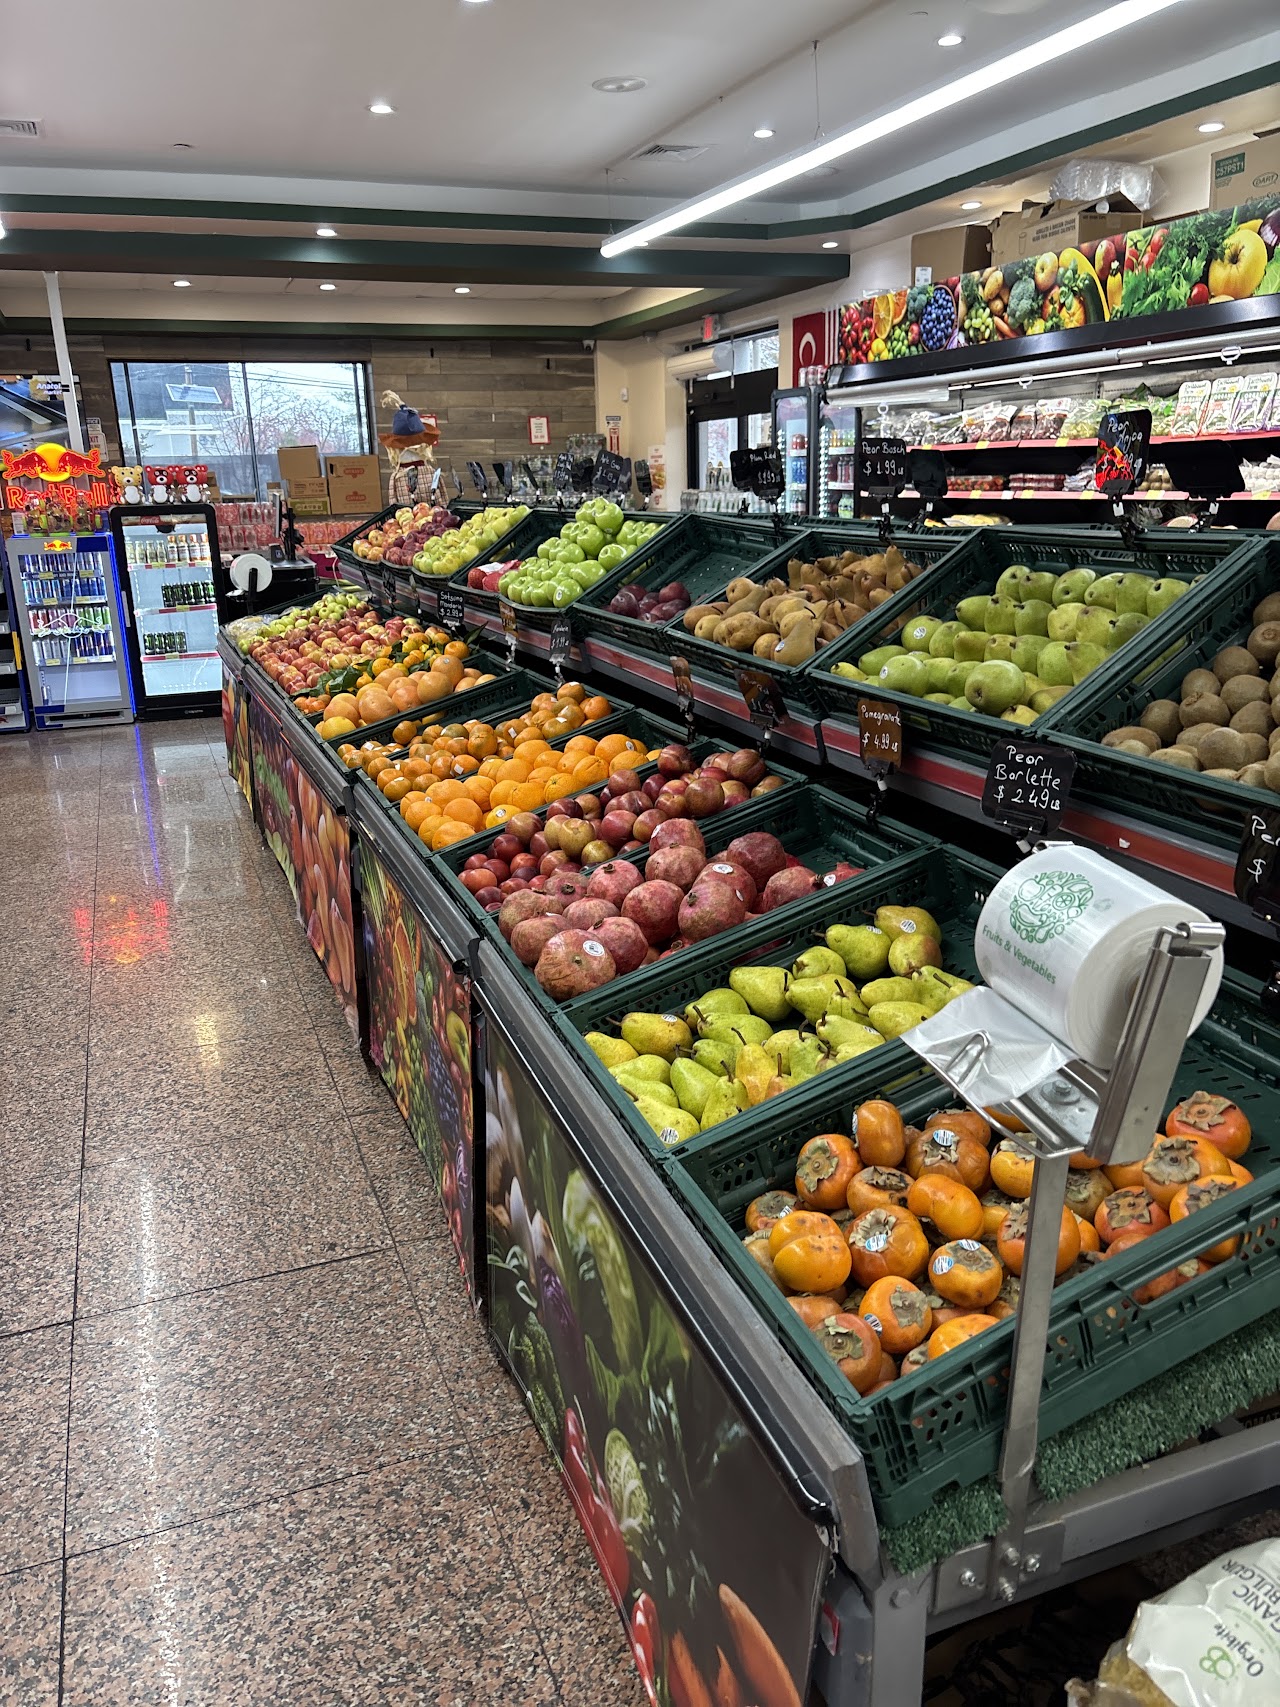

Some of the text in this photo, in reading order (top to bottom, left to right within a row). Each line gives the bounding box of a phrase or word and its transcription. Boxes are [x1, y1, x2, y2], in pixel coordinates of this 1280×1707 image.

[6, 482, 108, 510] Rd Bll
[873, 732, 890, 750] 4.99
[993, 784, 1005, 804] $
[1251, 815, 1280, 847] Pe
[1246, 858, 1267, 884] $
[983, 924, 1057, 985] Fruits & Vegetables
[1221, 1559, 1280, 1605] BULGUR
